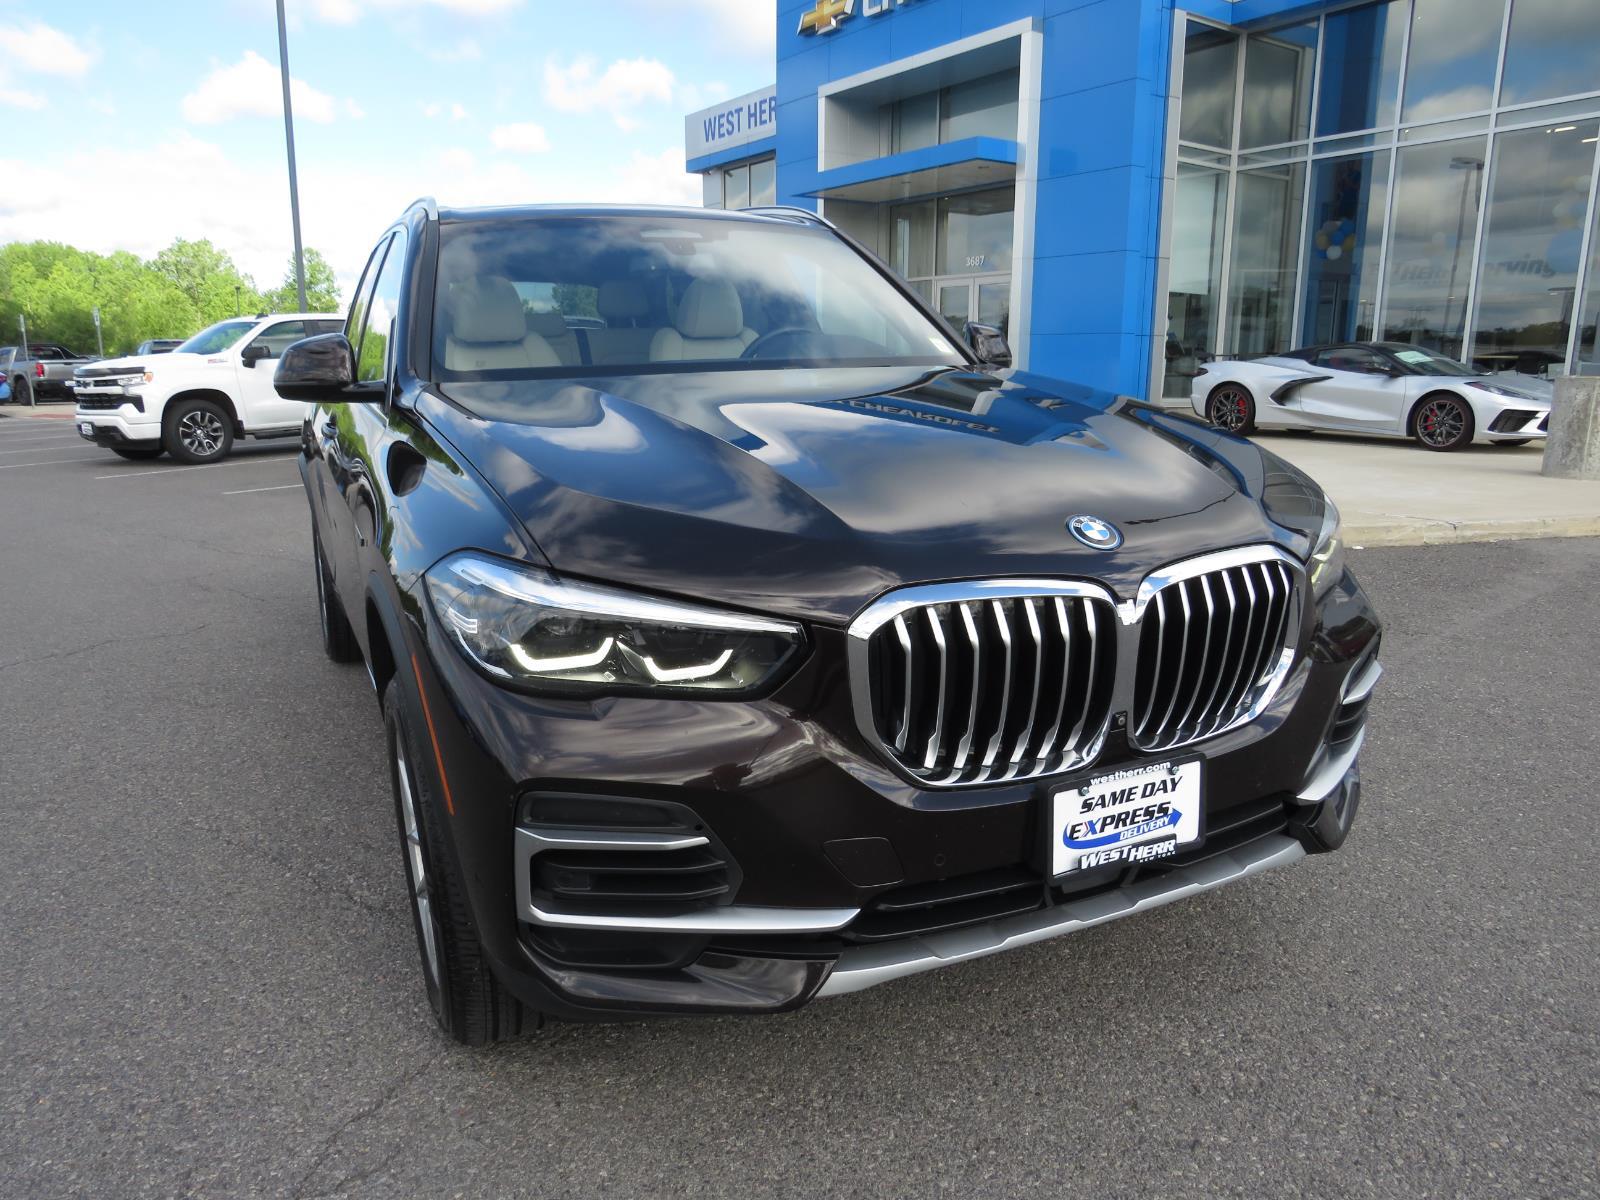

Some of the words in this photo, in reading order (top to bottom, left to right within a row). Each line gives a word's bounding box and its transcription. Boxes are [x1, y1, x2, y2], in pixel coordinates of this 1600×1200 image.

[703, 107, 743, 143] WEST
[965, 255, 985, 267] 3687
[1090, 761, 1171, 785] westherr.com
[1079, 785, 1138, 814] SAME
[1140, 775, 1183, 799] DAY
[1068, 801, 1171, 841] EXPRESS
[1119, 814, 1172, 841] DELIVERY
